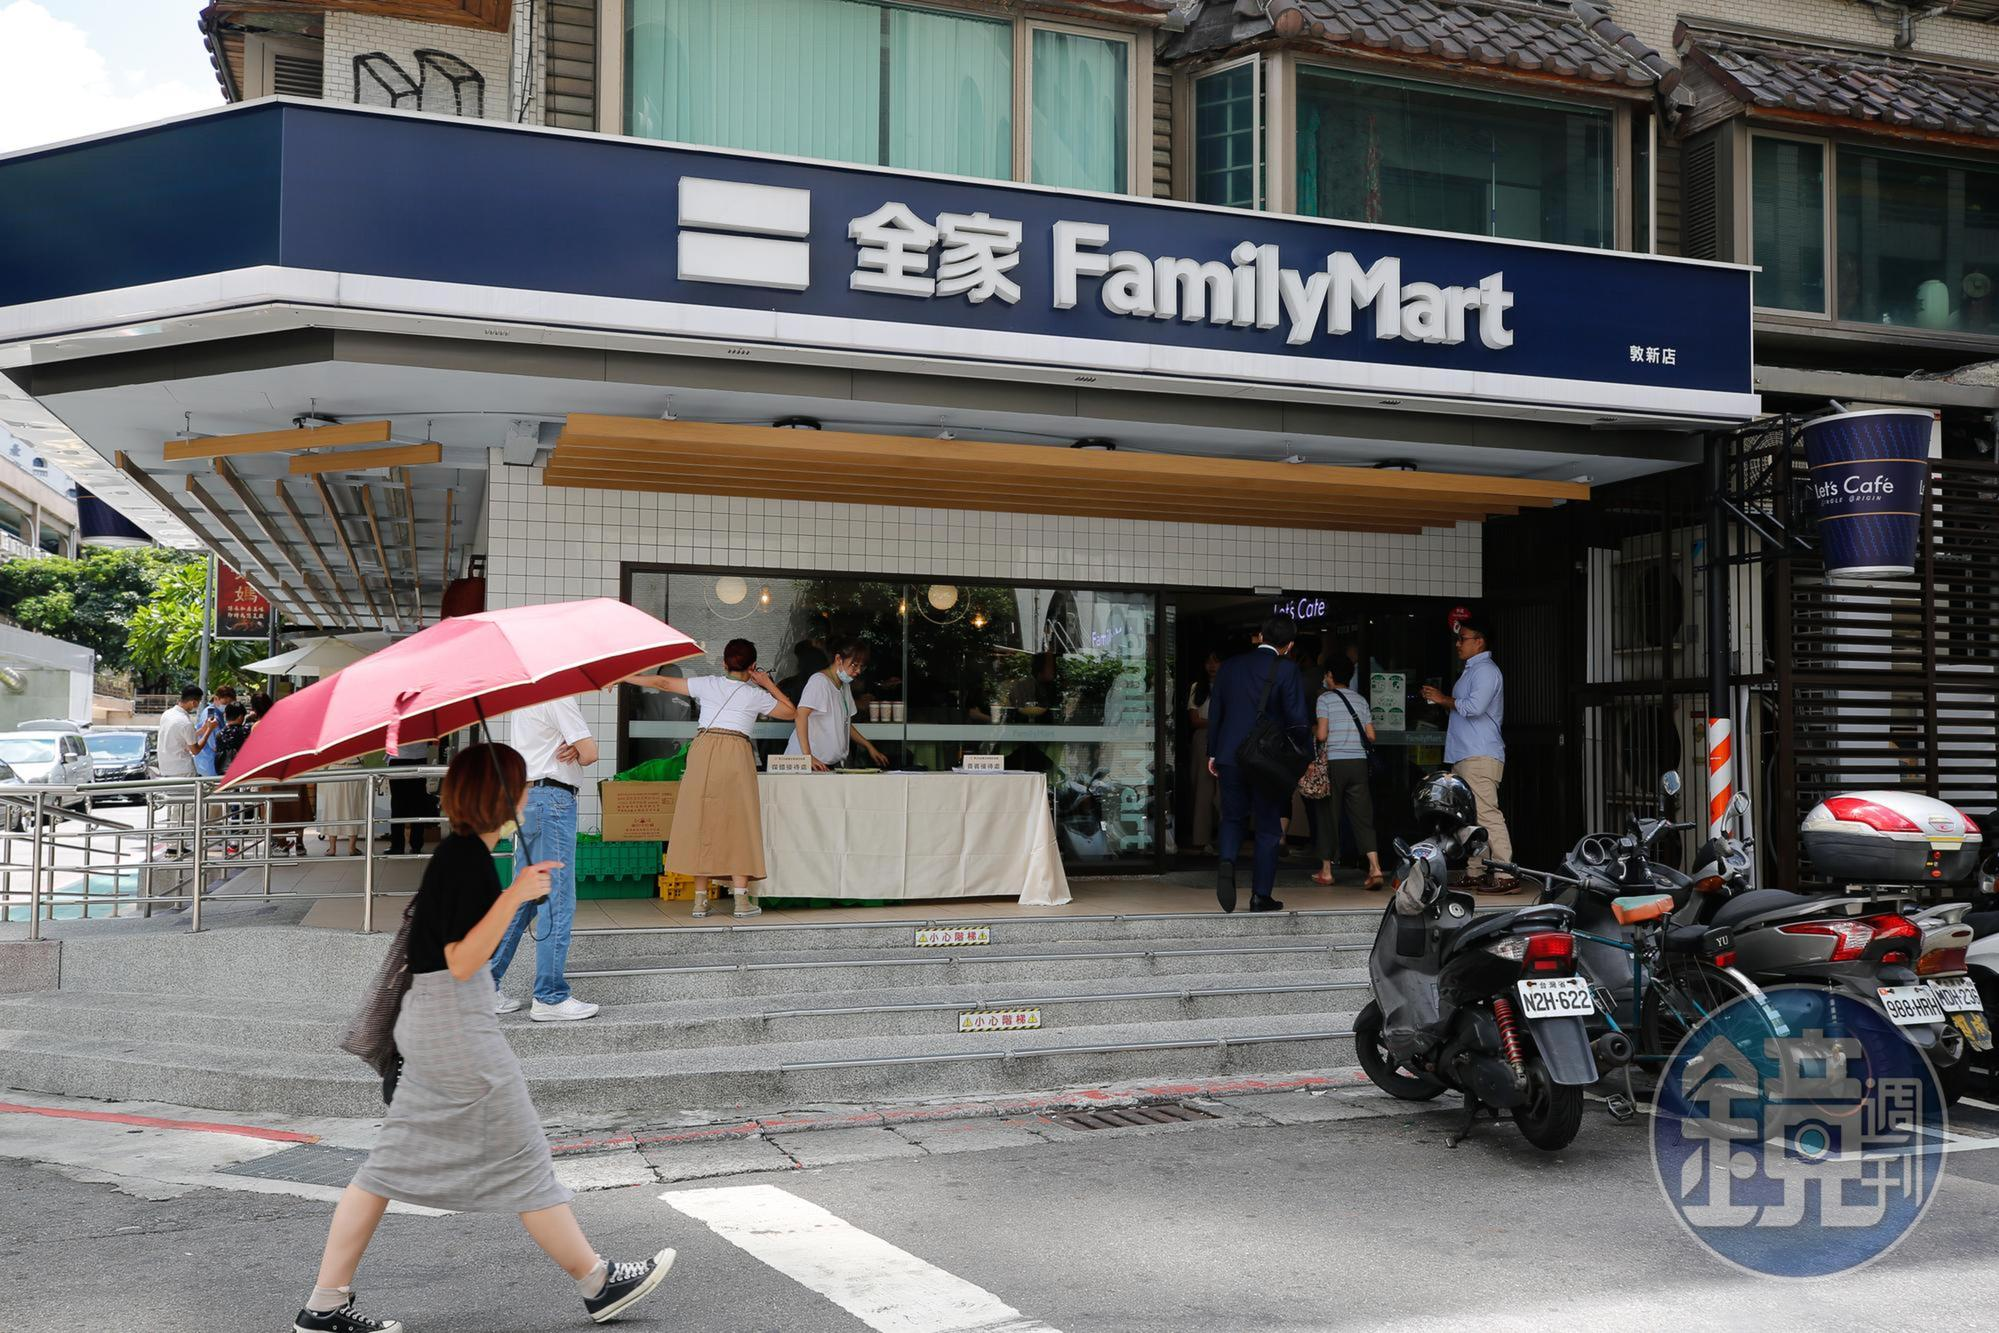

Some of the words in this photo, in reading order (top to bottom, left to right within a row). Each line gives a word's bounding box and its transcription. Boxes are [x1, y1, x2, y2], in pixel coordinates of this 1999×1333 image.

[848, 200, 1023, 304] 全家
[1052, 219, 1515, 351] FamilyMart
[1629, 344, 1677, 366] 敦新店
[1814, 480, 1839, 499] Let's
[1843, 475, 1894, 494] Café
[929, 931, 977, 943] 小心階梯
[1715, 935, 1730, 947] YU
[1523, 990, 1592, 1012] N2H-622
[1887, 997, 1942, 1018] 988-HRH
[975, 1014, 1026, 1027] 小心階梯
